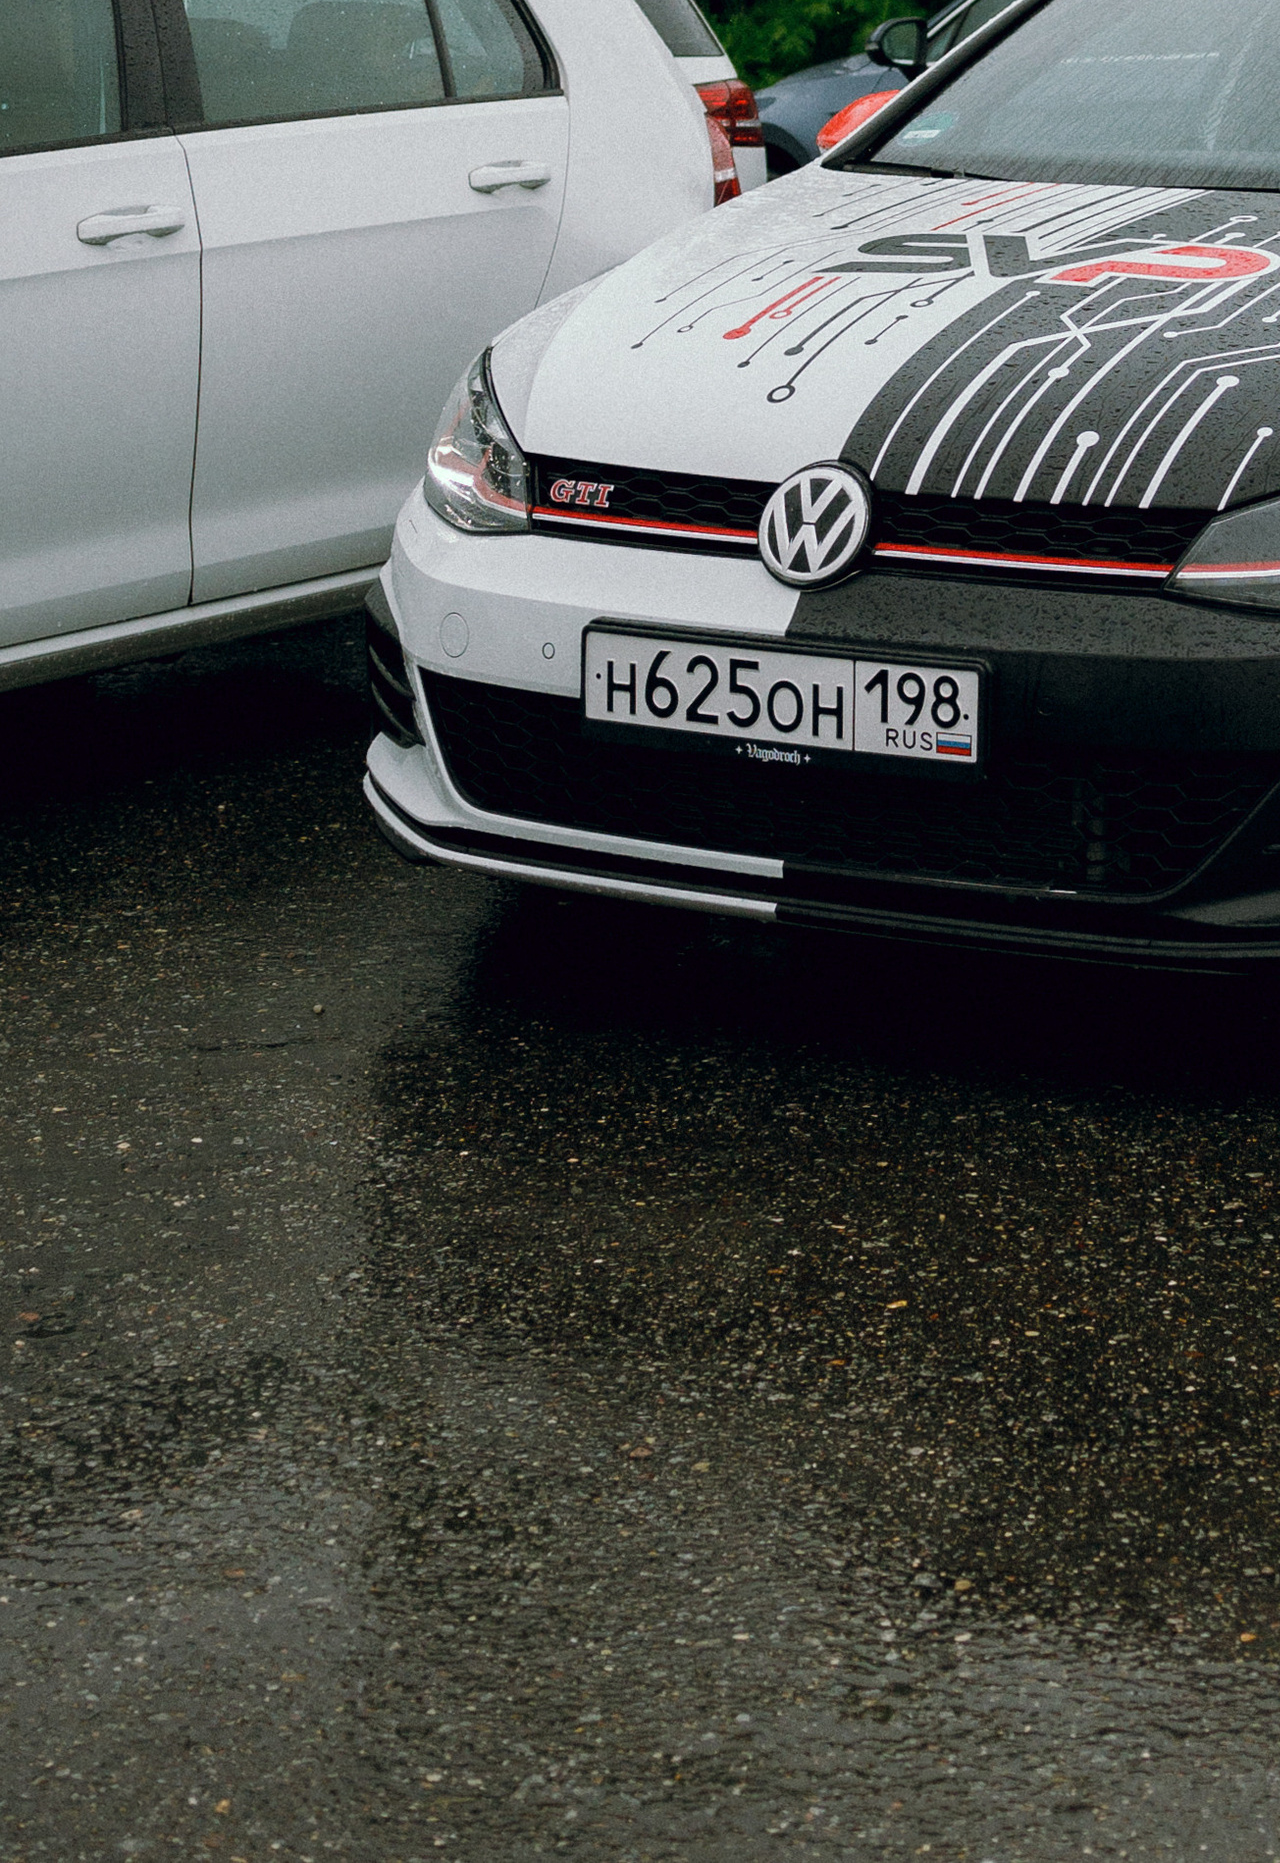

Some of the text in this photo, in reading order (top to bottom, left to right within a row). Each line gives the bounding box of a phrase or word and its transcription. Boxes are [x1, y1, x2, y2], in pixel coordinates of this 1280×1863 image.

[812, 232, 1280, 284] SVP
[550, 479, 613, 508] GTI
[863, 668, 960, 729] 198
[884, 728, 934, 752] RUS
